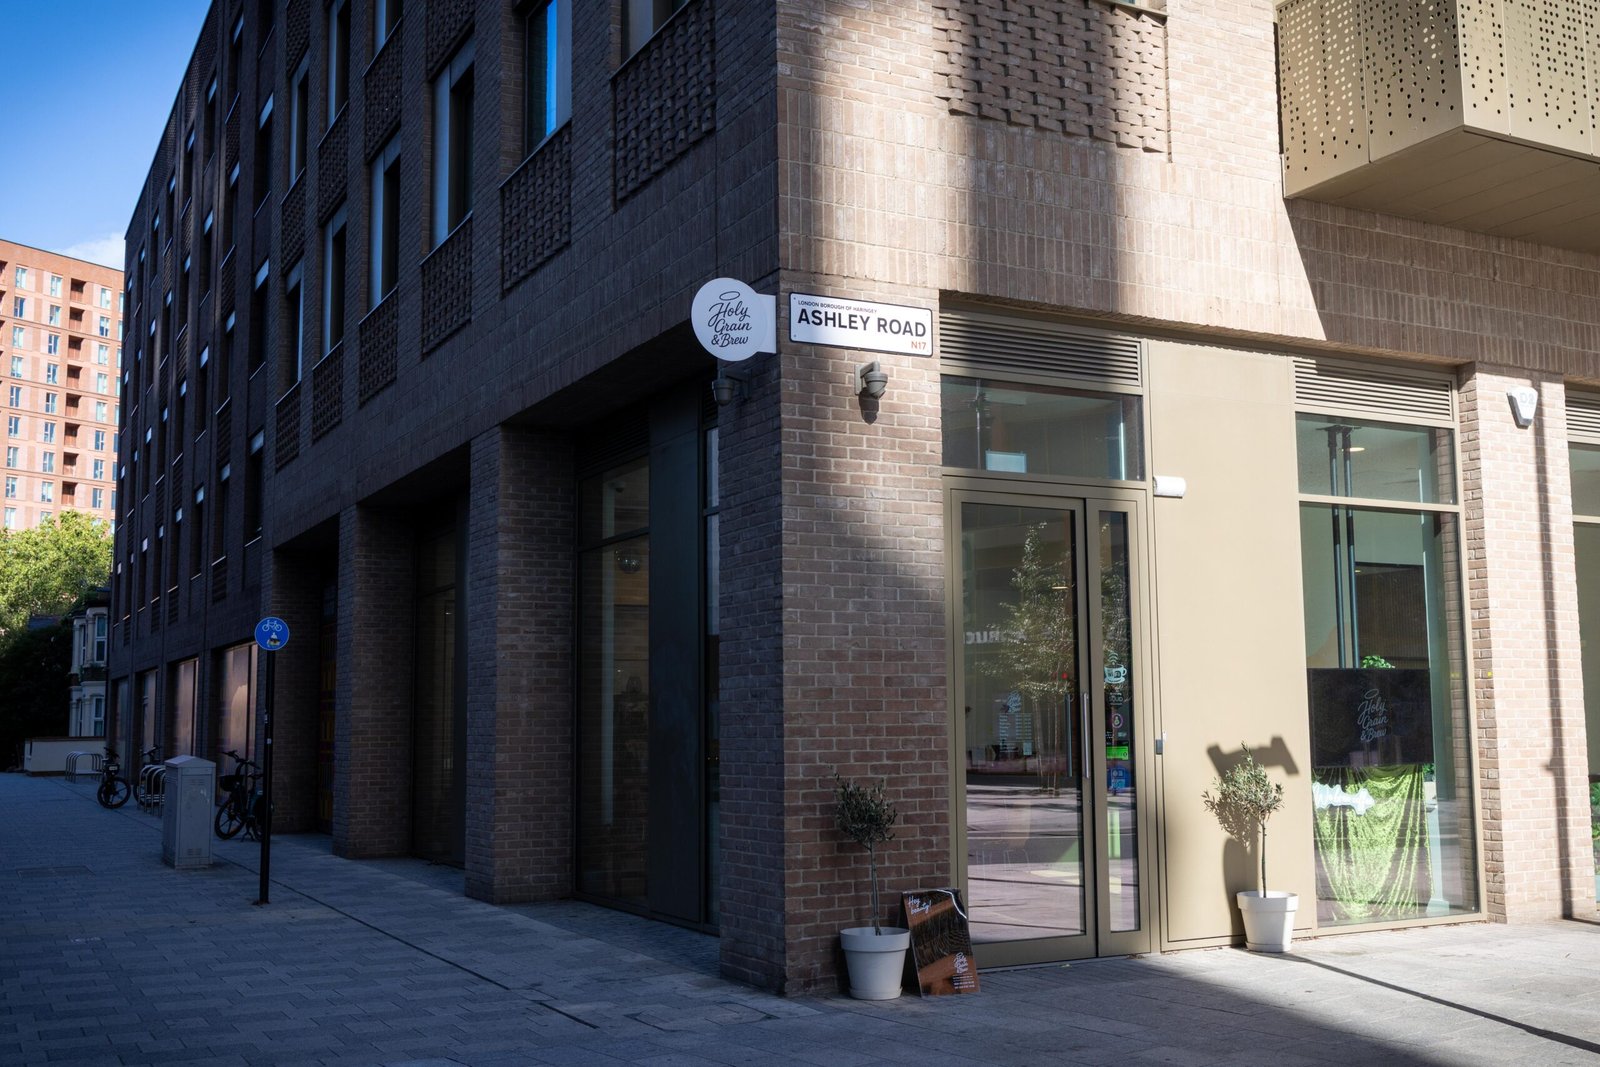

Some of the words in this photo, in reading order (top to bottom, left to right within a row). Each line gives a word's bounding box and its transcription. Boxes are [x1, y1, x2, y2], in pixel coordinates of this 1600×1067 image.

[798, 300, 820, 308] LONDON
[708, 300, 751, 327] Holy
[714, 318, 752, 335] Grain
[797, 308, 871, 331] ASHLEY
[877, 317, 927, 337] ROAD
[911, 341, 927, 350] N17
[1357, 696, 1389, 725] Holy
[1362, 715, 1389, 730] Grain
